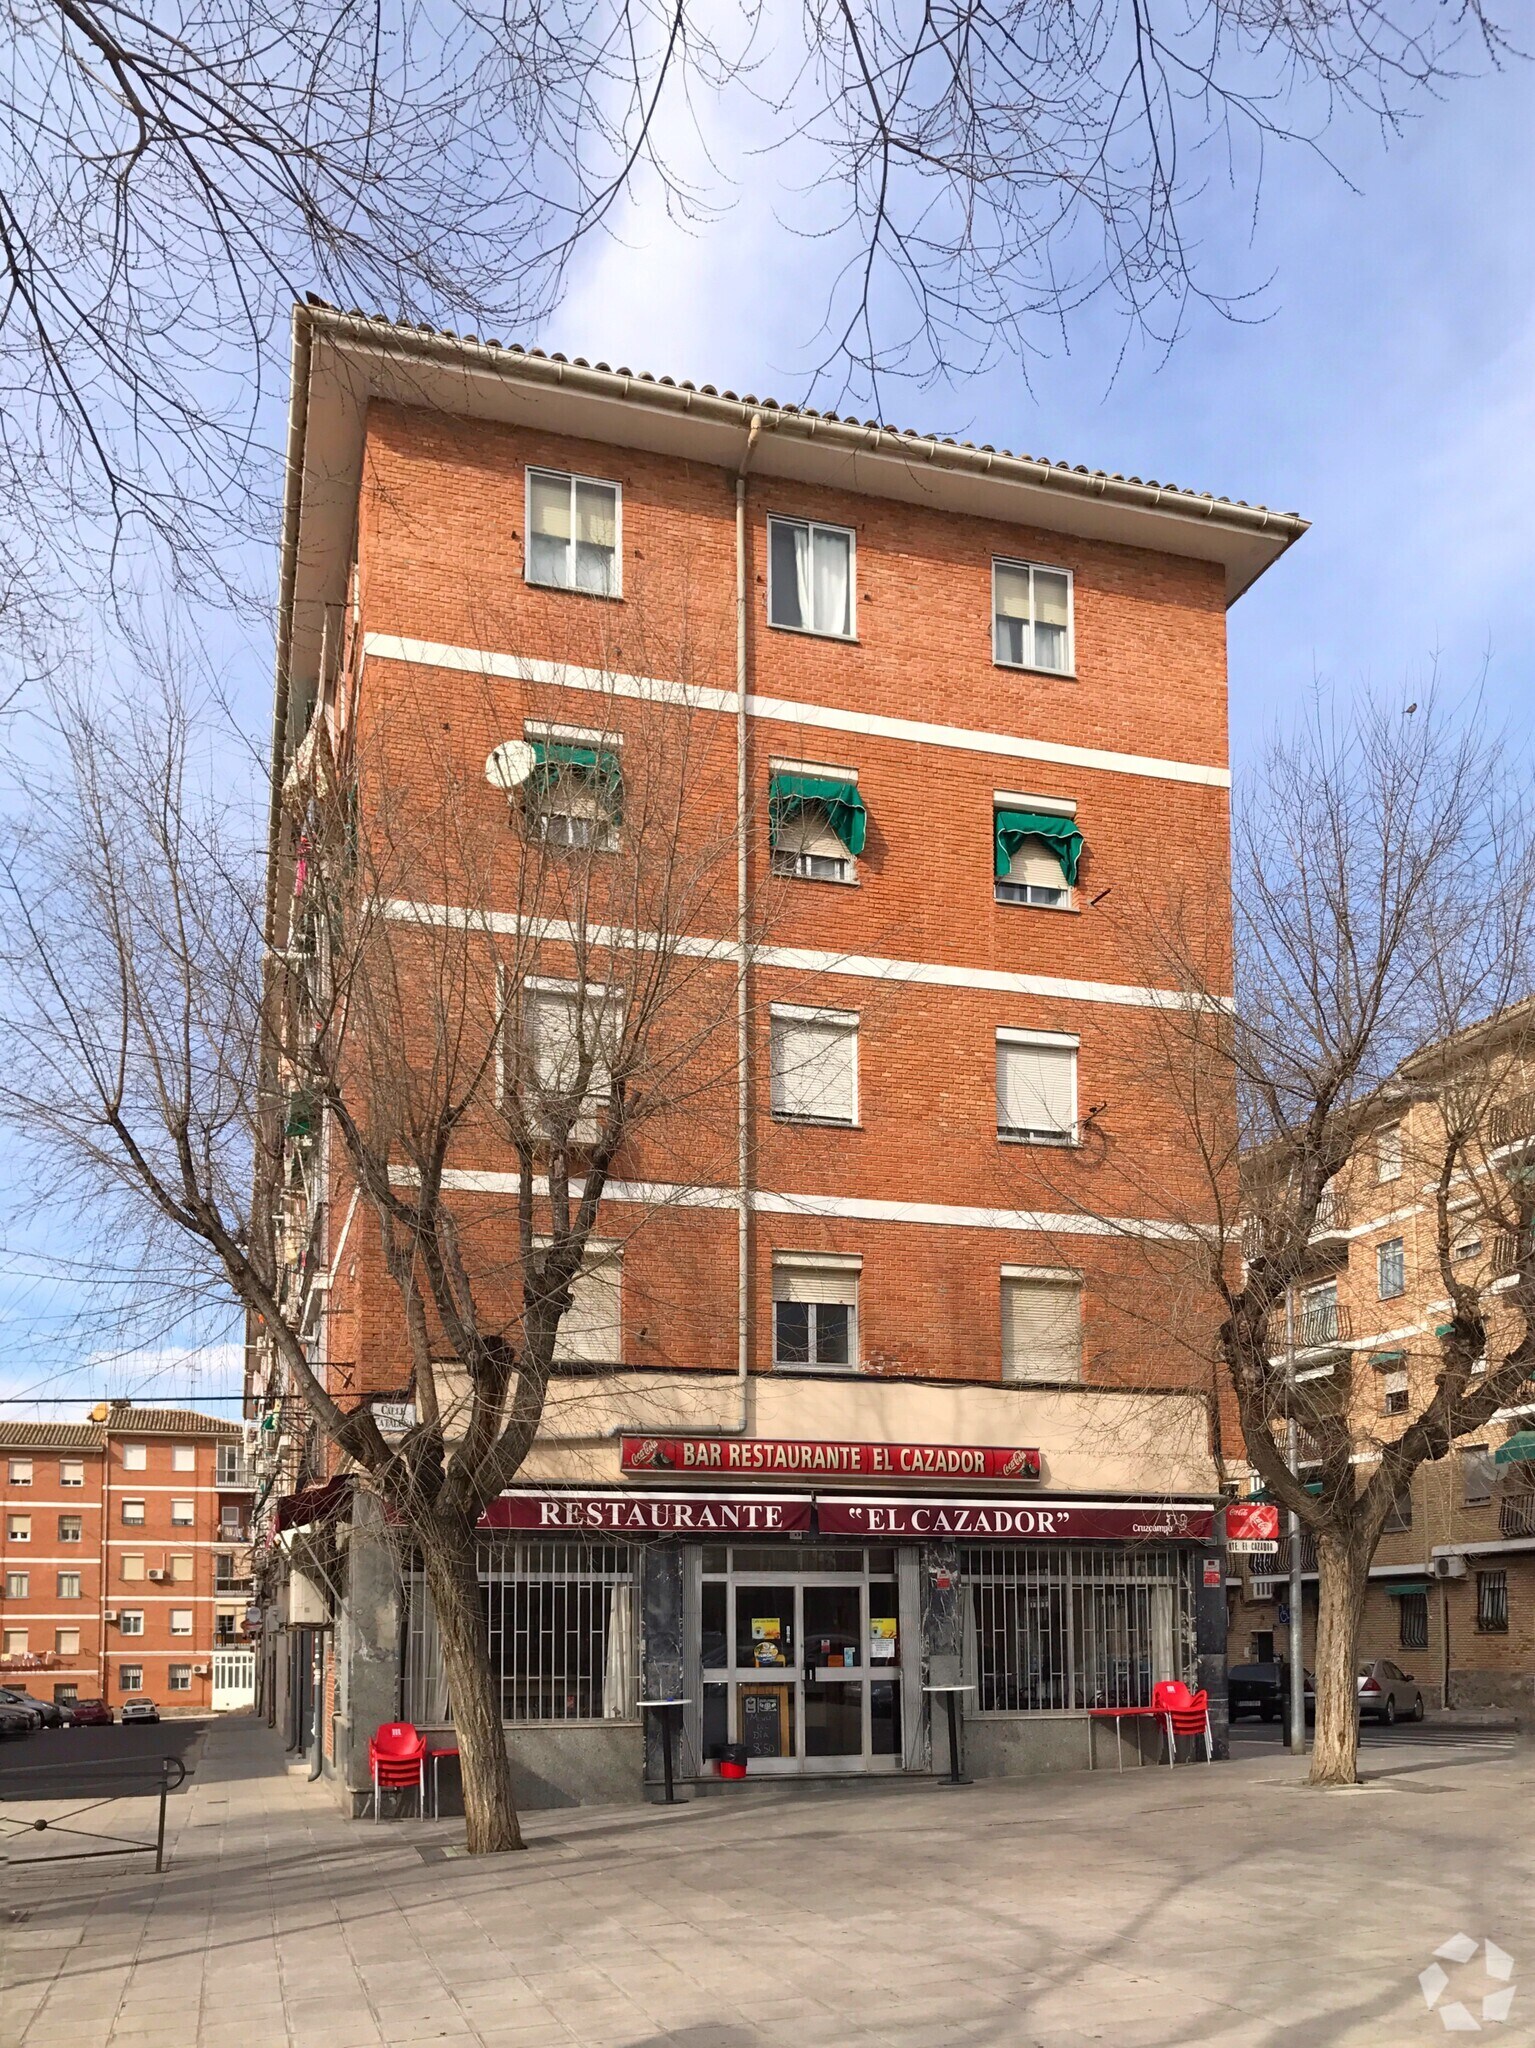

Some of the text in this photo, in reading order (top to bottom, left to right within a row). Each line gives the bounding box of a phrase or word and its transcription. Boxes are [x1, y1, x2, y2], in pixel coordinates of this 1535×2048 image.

[683, 1442, 985, 1473] BAR RESTAURANTE EL CAZADOR
[538, 1501, 784, 1528] RESTAURANTE
[1132, 1524, 1173, 1536] Cruzcampo
